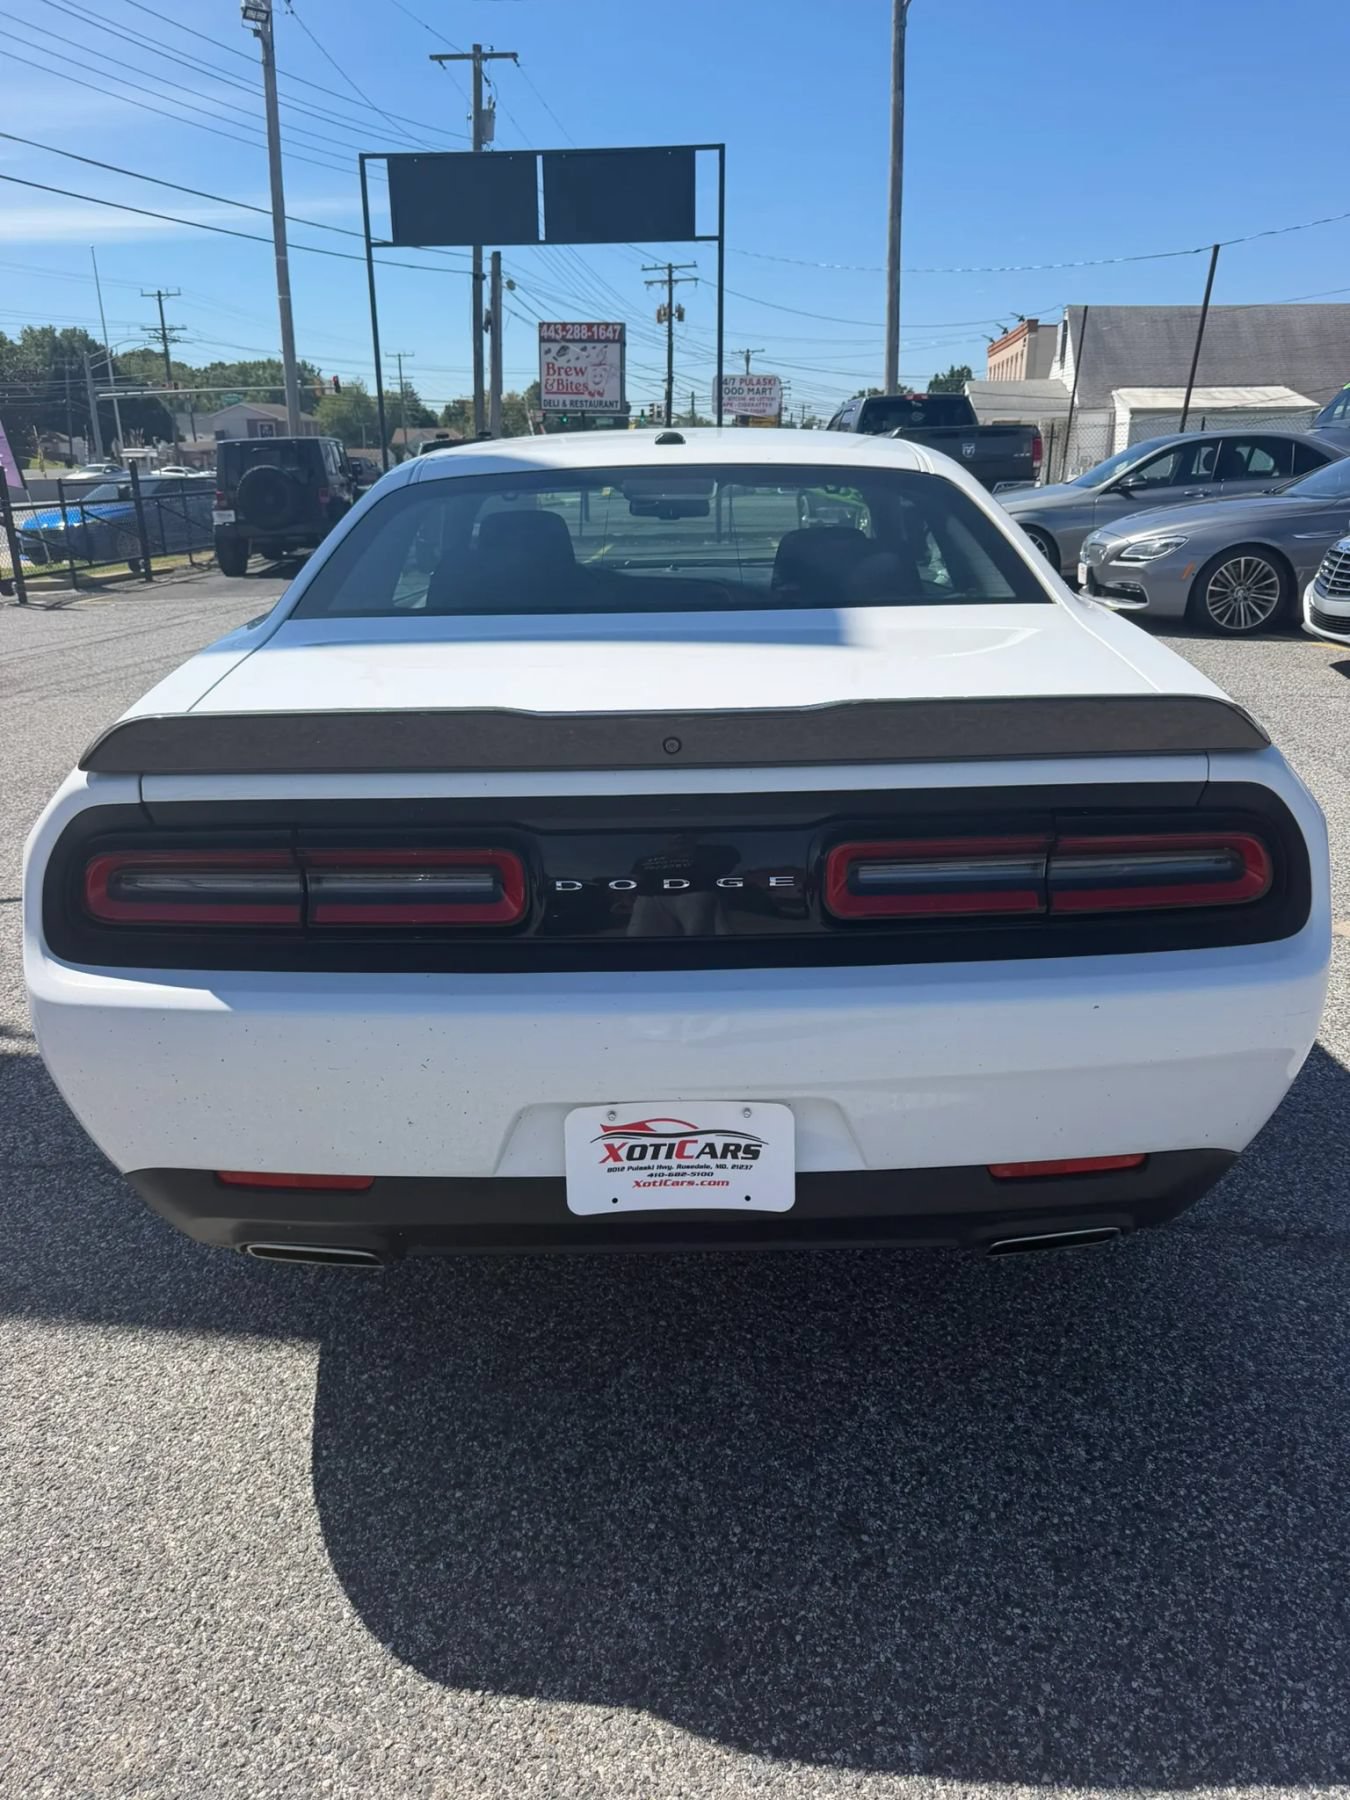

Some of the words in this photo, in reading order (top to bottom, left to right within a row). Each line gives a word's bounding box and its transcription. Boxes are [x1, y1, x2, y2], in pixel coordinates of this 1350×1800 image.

[541, 324, 621, 340] 443-288-1647
[545, 362, 587, 377] Brew
[739, 377, 776, 386] PULASKI
[723, 387, 744, 395] OOD
[747, 387, 773, 395] MART
[543, 399, 559, 408] DELI
[561, 399, 567, 408] &
[569, 399, 619, 409] RESTAURANT
[555, 876, 795, 891] DODGE
[627, 1164, 655, 1172] Pulaski
[656, 1164, 674, 1172] Hwy.
[676, 1163, 713, 1171] Rosedale,
[632, 1178, 730, 1189] XotiCars.com
